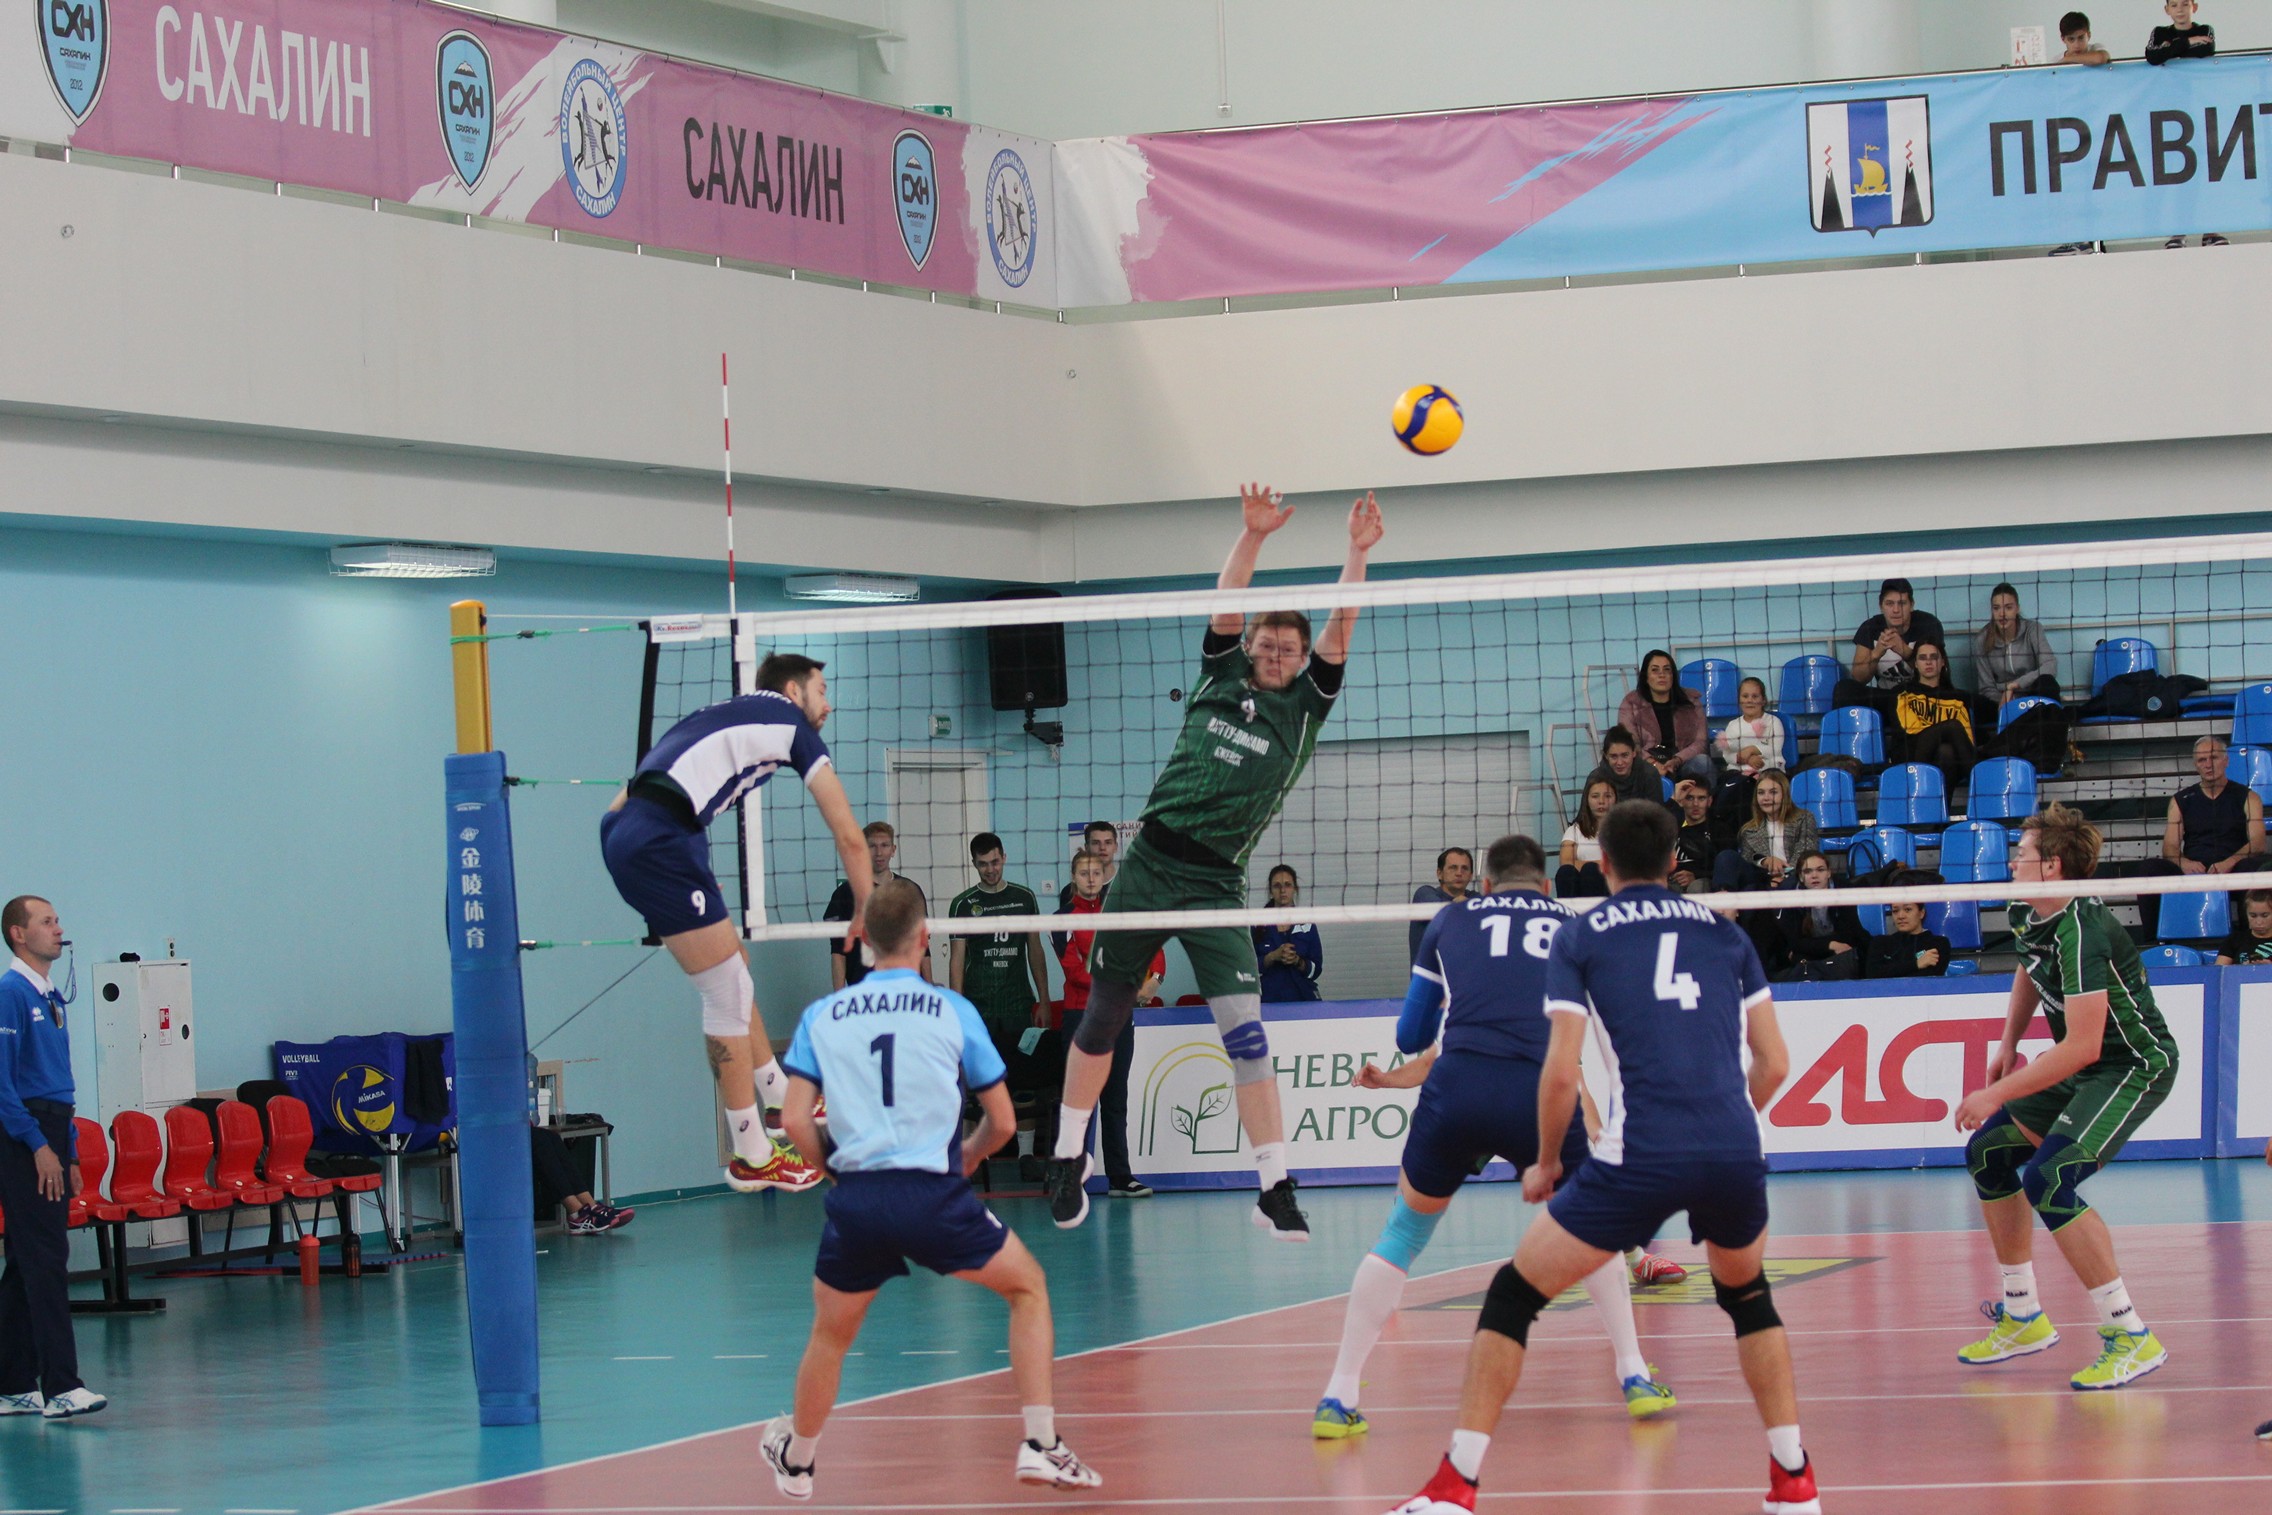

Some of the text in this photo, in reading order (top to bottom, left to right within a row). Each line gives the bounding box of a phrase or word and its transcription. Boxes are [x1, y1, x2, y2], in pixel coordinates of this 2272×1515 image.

[156, 5, 371, 137] САХАЛИН
[612, 92, 627, 157] ЦЕНТР
[1989, 103, 2272, 197] ПРАВИ
[684, 117, 845, 225] САХАЛИН
[575, 185, 616, 216] САХАЛИН
[460, 847, 485, 949] 金陵体育
[691, 889, 706, 917] 9
[1589, 900, 1717, 932] САХАЛИН
[1480, 914, 1562, 959] 18
[1653, 931, 1702, 1010] 4
[832, 992, 942, 1021] САХАЛИН
[282, 1054, 320, 1064] VOLLEYBALL
[870, 1033, 896, 1108] 1
[1291, 1103, 1416, 1143] АГРО
